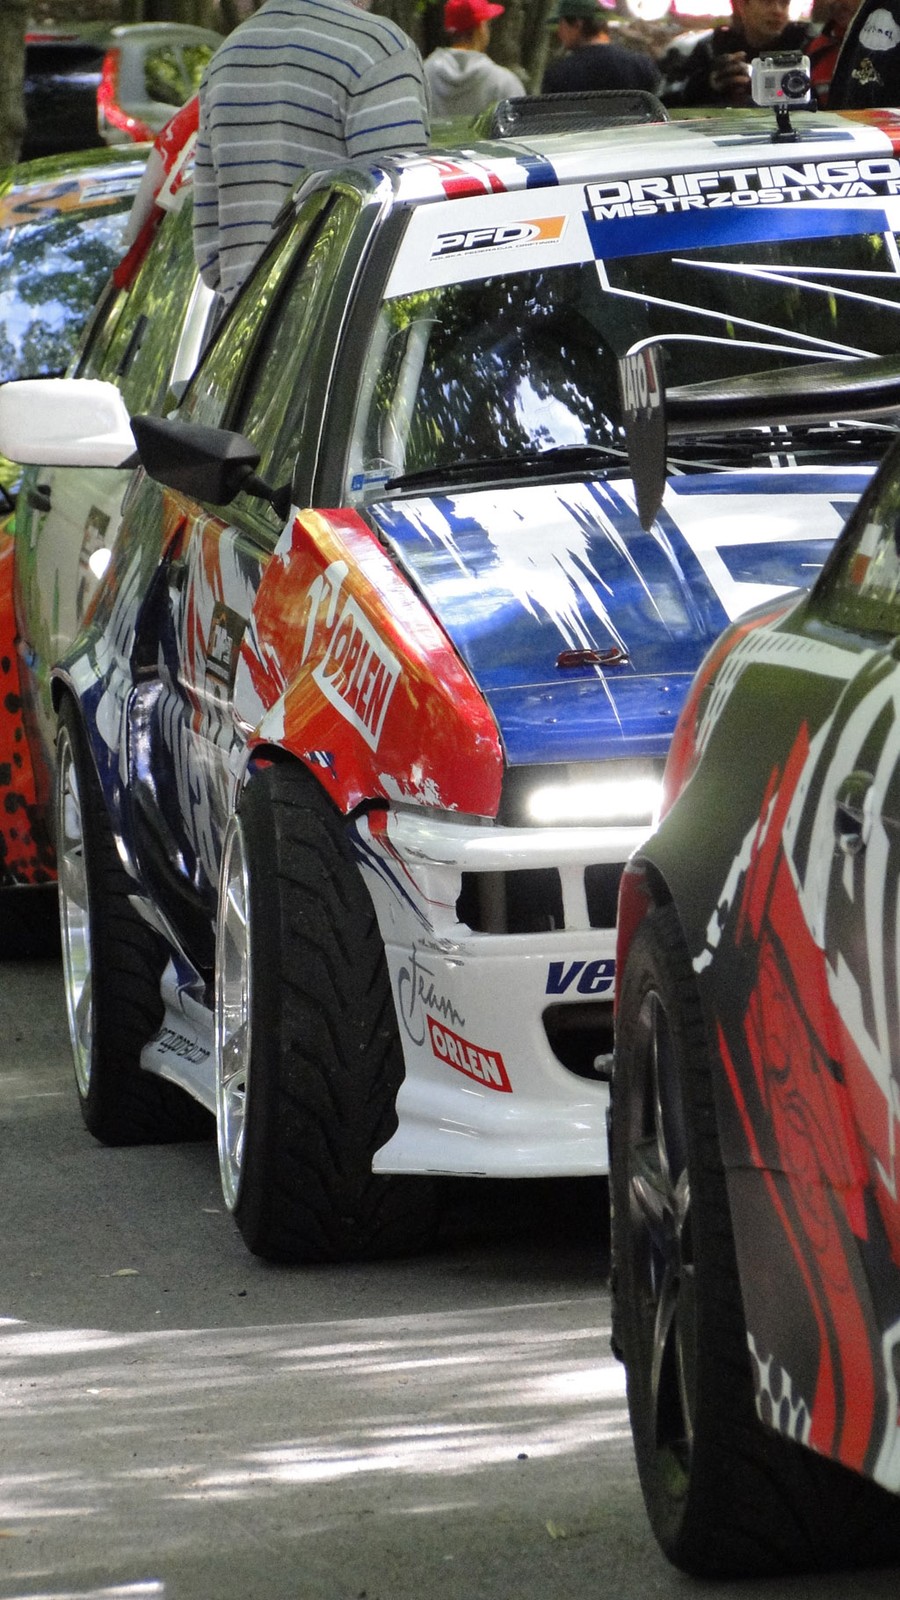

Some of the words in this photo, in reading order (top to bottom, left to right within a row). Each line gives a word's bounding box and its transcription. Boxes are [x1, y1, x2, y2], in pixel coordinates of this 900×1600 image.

[586, 157, 900, 207] DRIFTINGO
[592, 181, 877, 221] MISTRZOSTWA
[432, 223, 537, 255] PFD
[618, 352, 648, 411] YATO
[322, 612, 394, 738] ORLEN
[545, 958, 616, 995] ve
[431, 1024, 504, 1087] ORLEN
